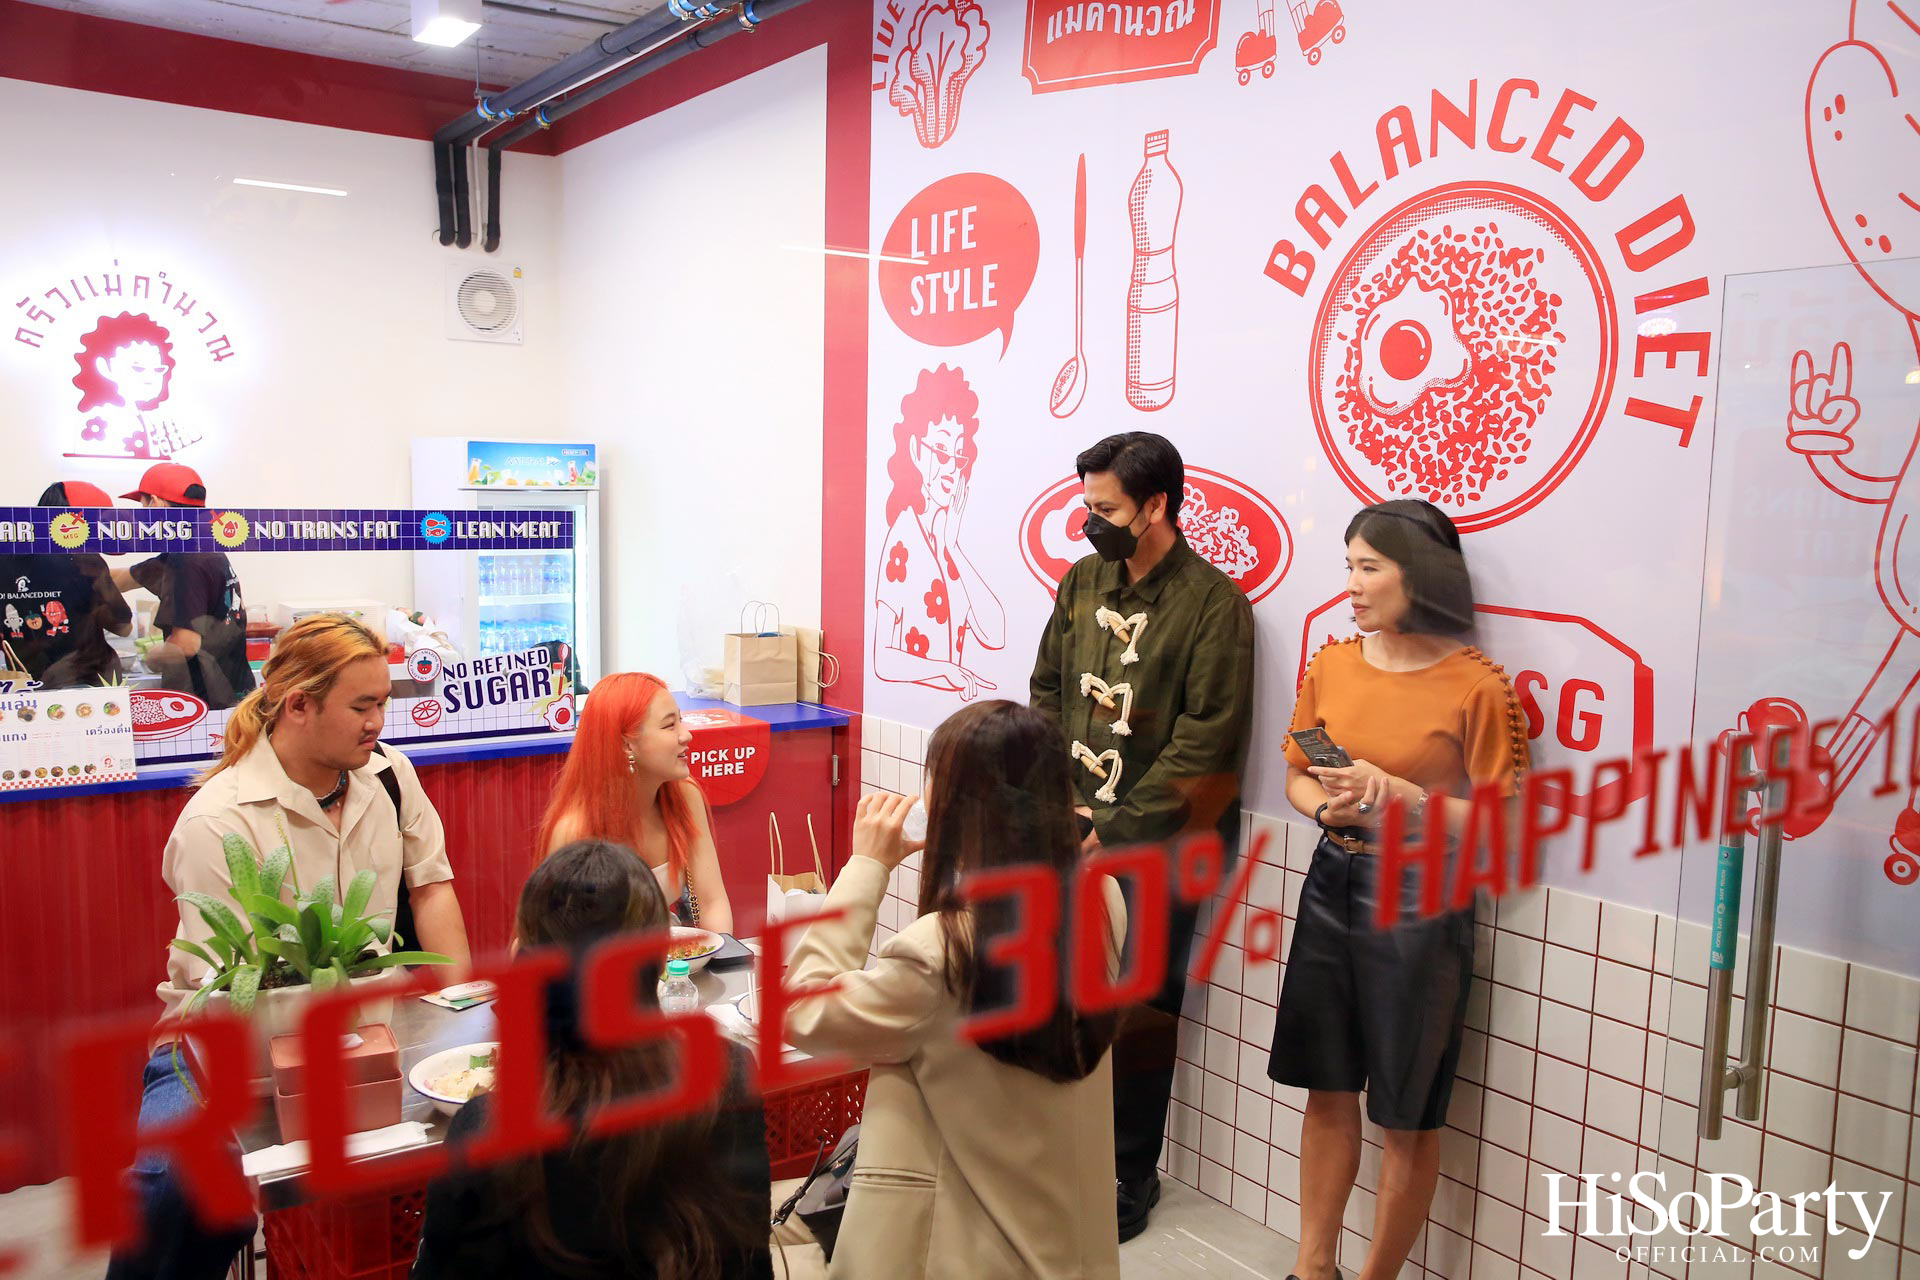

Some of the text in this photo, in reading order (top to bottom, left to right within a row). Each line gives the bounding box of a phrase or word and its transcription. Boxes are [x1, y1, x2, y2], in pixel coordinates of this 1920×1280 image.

[910, 205, 978, 259] LIFE
[1263, 78, 1712, 448] BALANCED DIET
[909, 263, 999, 316] STYLE
[97, 520, 192, 541] NO MSG
[254, 520, 401, 540] NO TRANS FAT
[456, 520, 562, 539] LEAN MEAT
[7, 591, 44, 600] BALANCED
[44, 590, 62, 598] DIET
[443, 649, 548, 681] NO REFINED
[443, 668, 552, 714] SUGAR
[1513, 669, 1606, 752] SG
[690, 746, 756, 764] PICK UP
[701, 761, 745, 778] HERE
[0, 906, 853, 1278] RCISE
[956, 828, 1282, 1044] 30%
[1371, 718, 1840, 932] HAPPINESS
